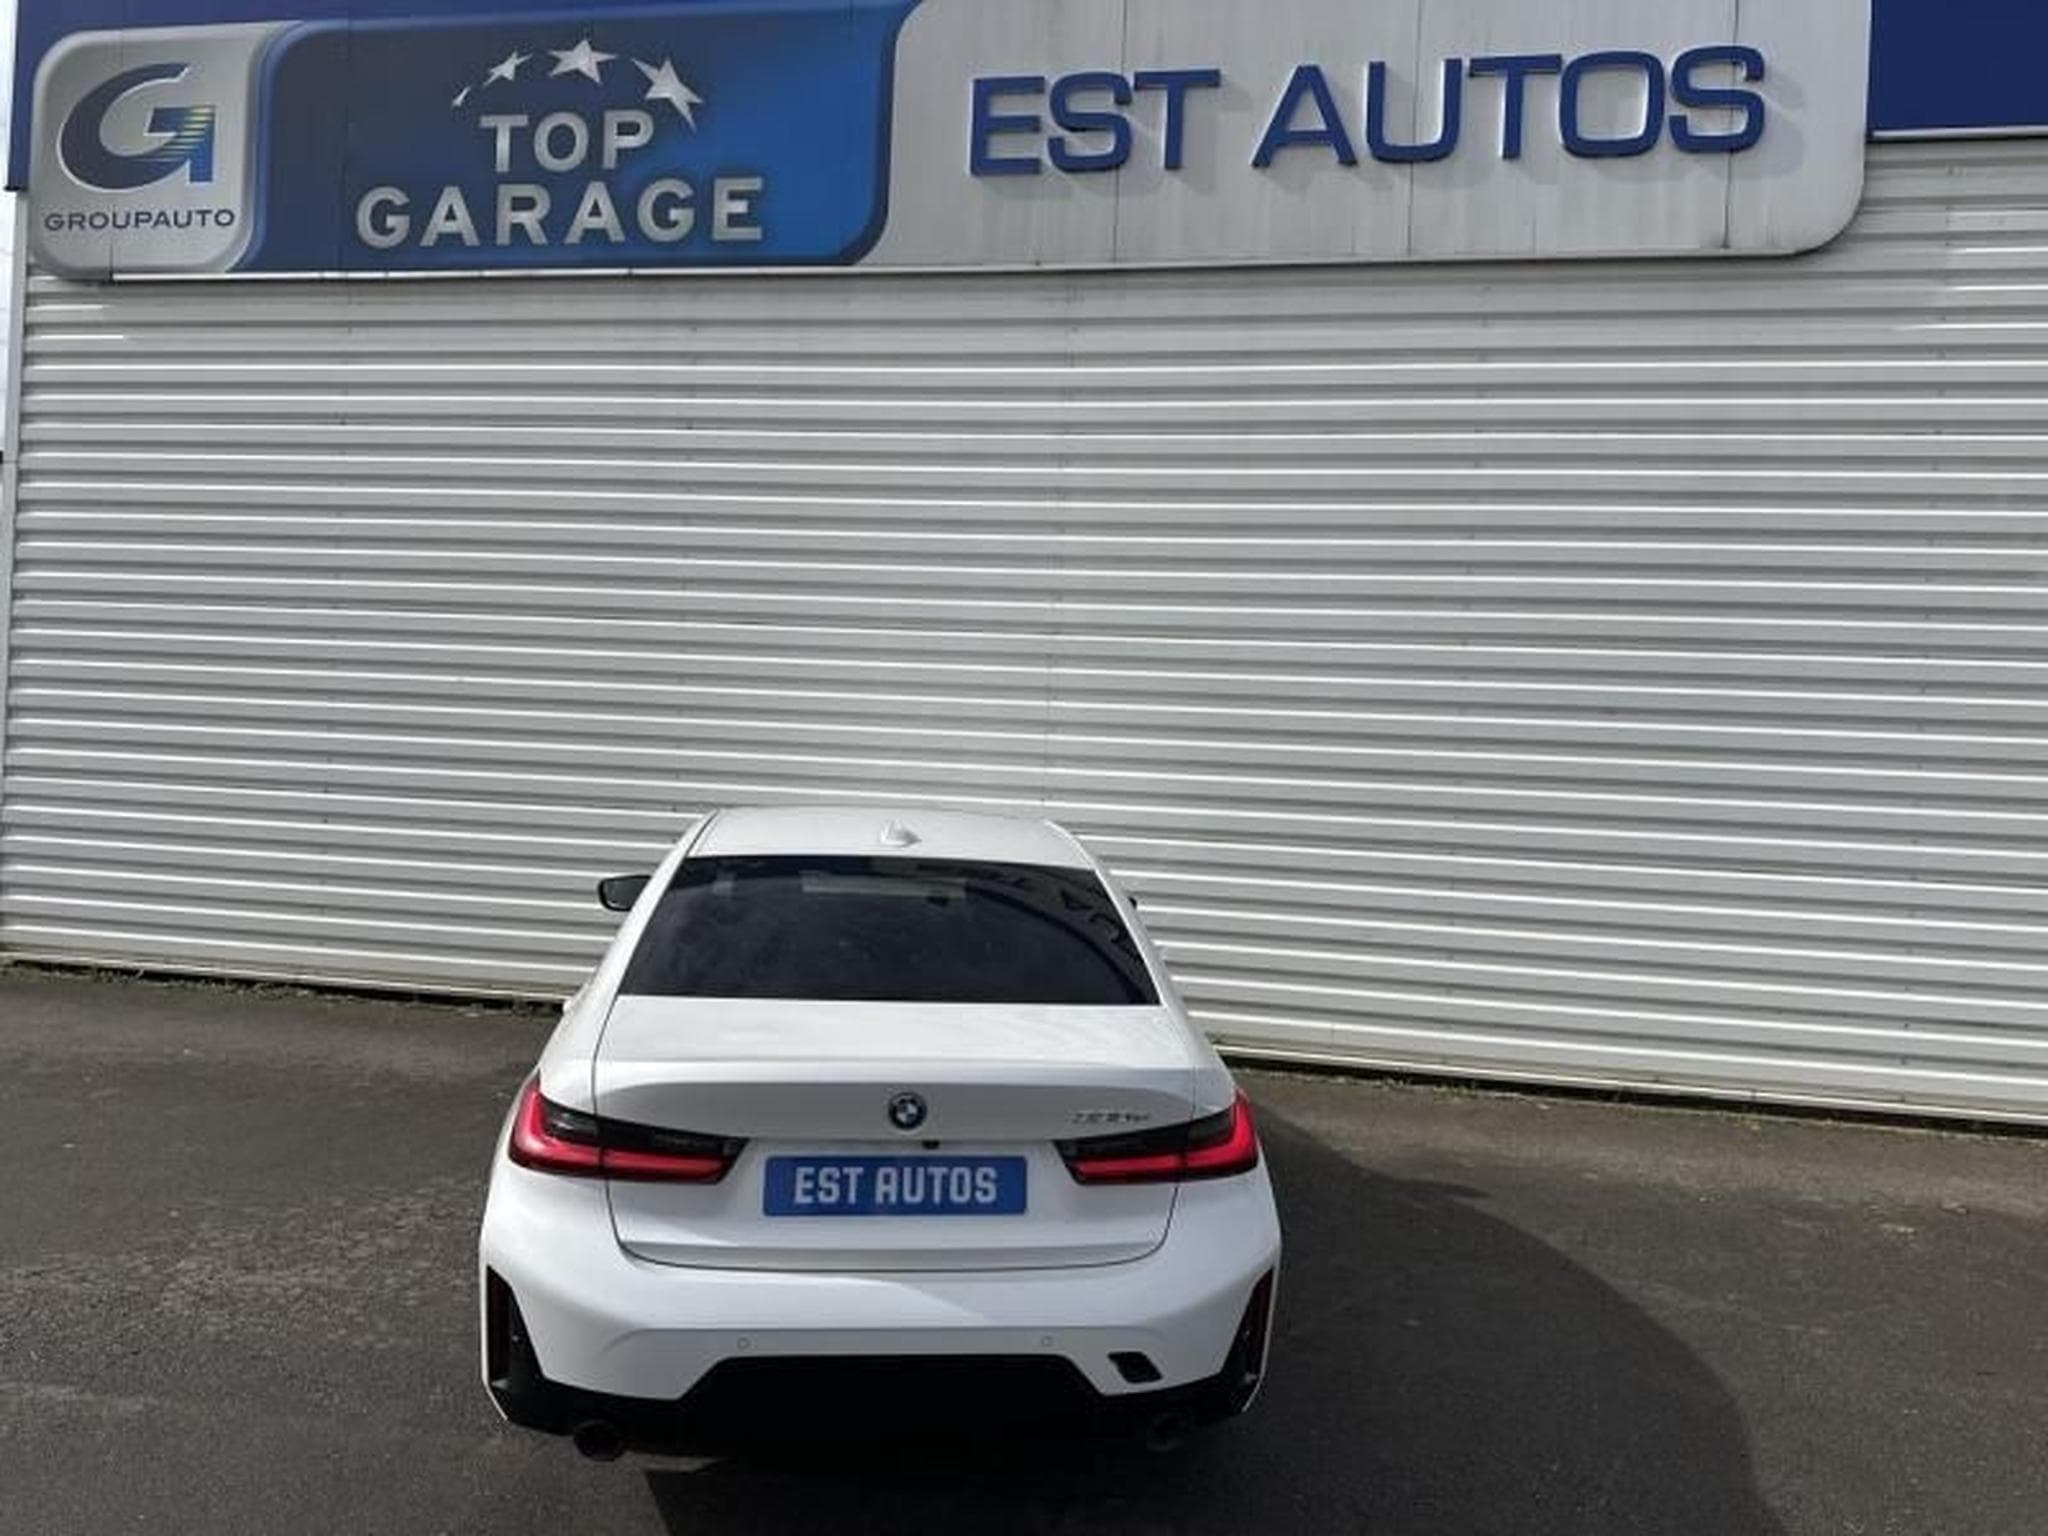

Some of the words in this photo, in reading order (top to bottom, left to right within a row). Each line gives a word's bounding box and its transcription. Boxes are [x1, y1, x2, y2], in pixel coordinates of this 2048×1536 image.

[479, 109, 656, 174] TOP
[969, 69, 1221, 176] EST
[1250, 45, 1767, 170] AUTOS
[43, 208, 235, 232] GROUPAUTO
[355, 176, 765, 250] GARAGE
[793, 1166, 862, 1205] EST
[875, 1165, 998, 1205] AUTOS
